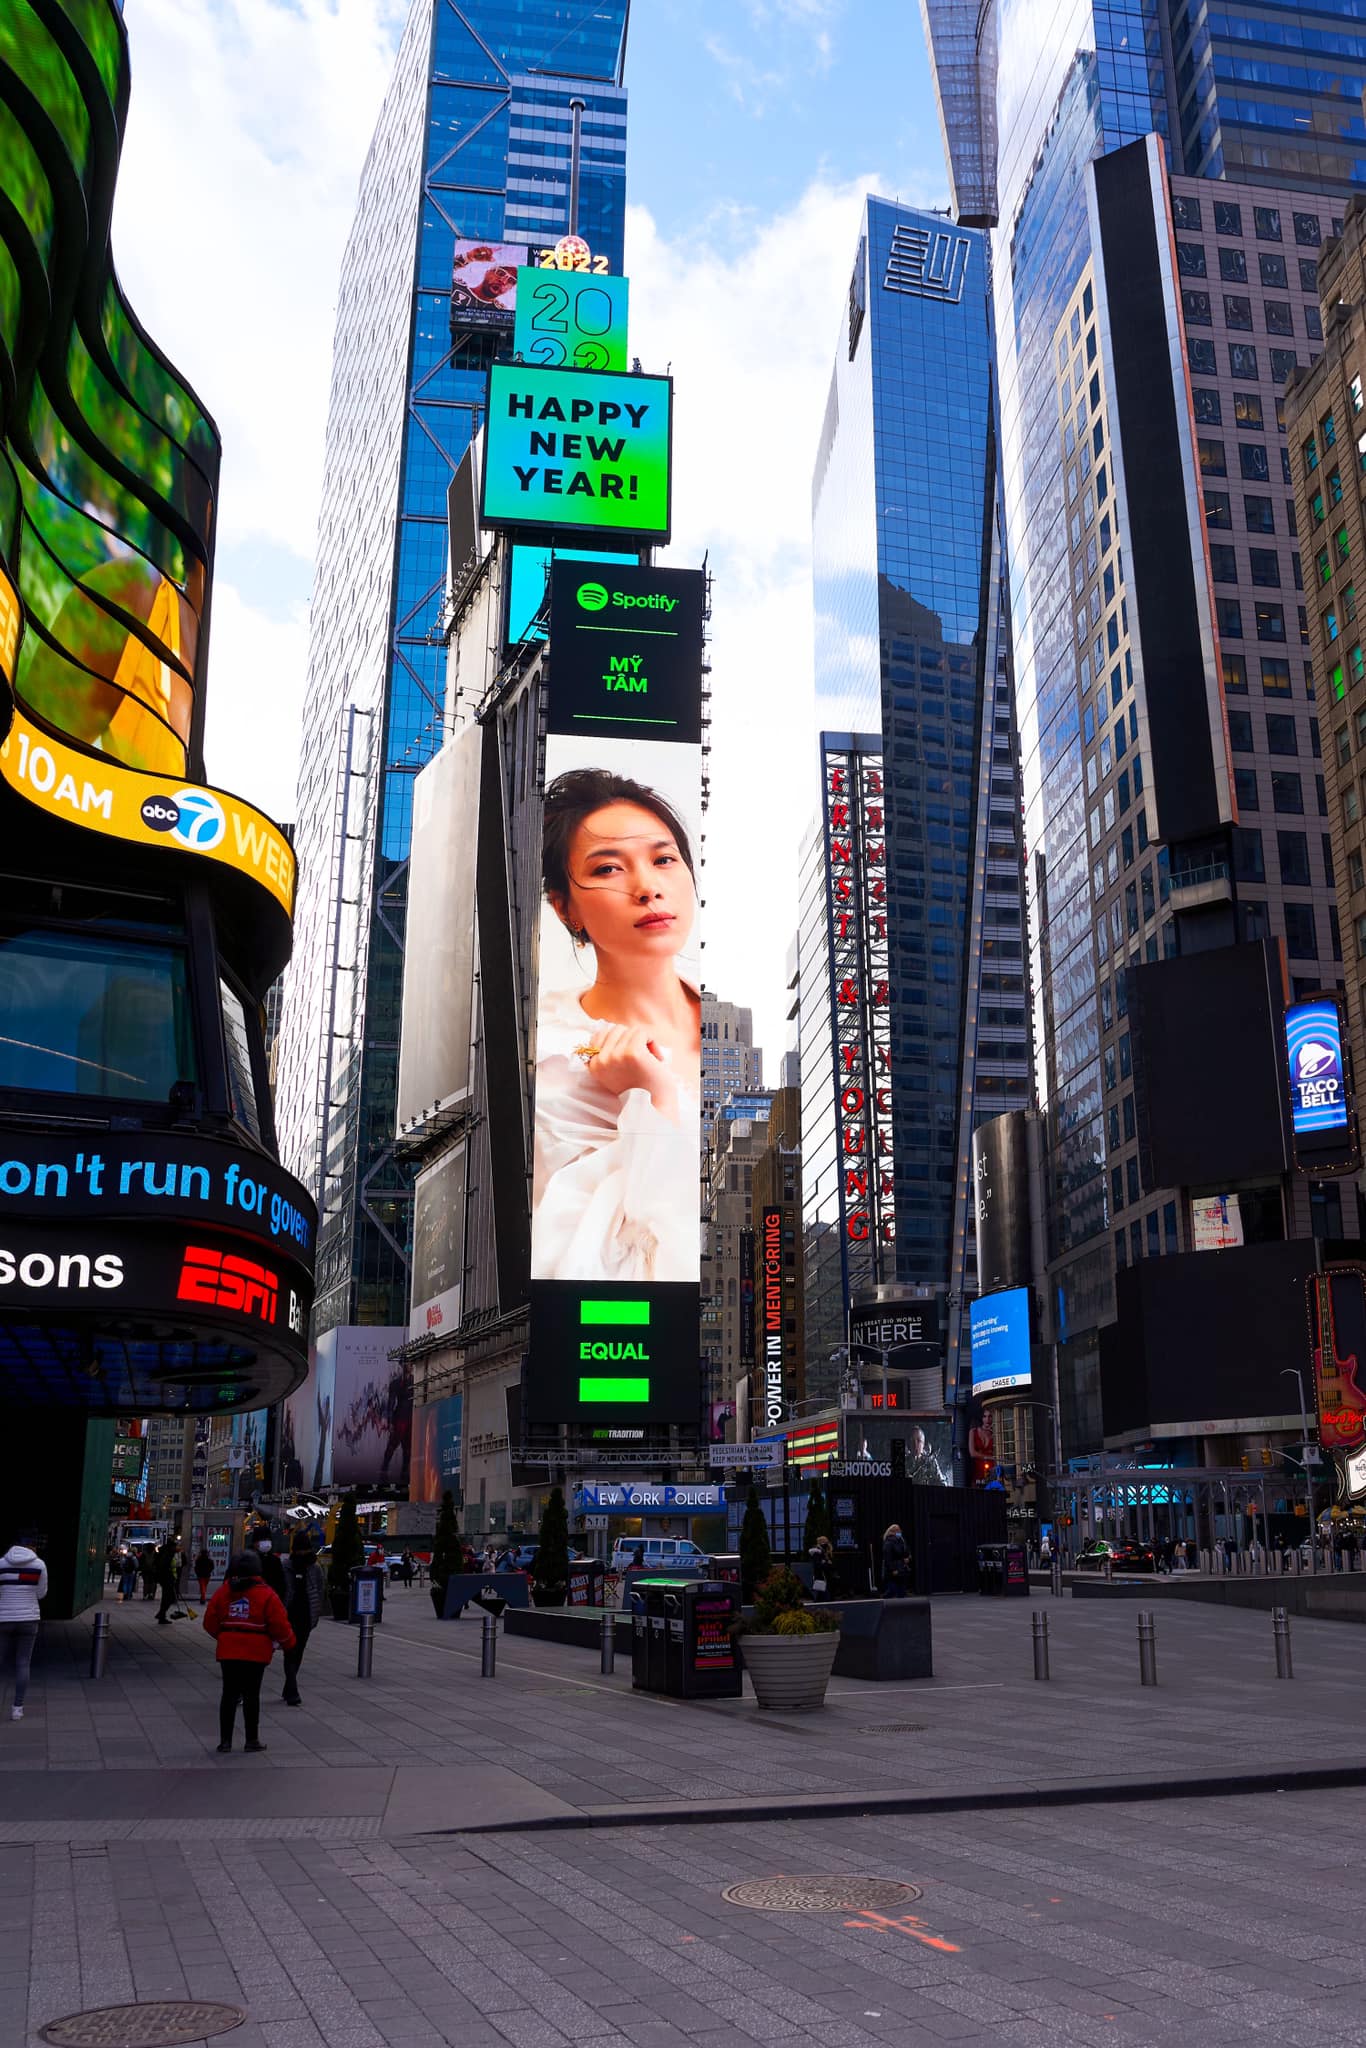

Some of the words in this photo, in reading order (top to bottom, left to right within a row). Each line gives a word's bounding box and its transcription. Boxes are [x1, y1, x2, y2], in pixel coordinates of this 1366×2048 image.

[539, 249, 609, 275] 2022
[532, 283, 612, 336] 20
[508, 393, 649, 428] HAPPY
[529, 431, 626, 462] NEW
[512, 466, 638, 500] YEAR!
[612, 591, 677, 612] Spotify
[602, 673, 648, 693] TÂM
[18, 733, 114, 820] 10AM
[142, 804, 178, 823] abc
[831, 769, 854, 939] ERNST
[837, 978, 858, 1005] &
[1297, 1078, 1339, 1096] TACO
[1301, 1090, 1340, 1108] BELL
[841, 1045, 871, 1242] YOUNG
[119, 1161, 212, 1200] run
[223, 1163, 268, 1216] for
[765, 1214, 781, 1331] MENTORING
[176, 1246, 279, 1324] ESPN
[867, 1323, 922, 1344] HERE
[579, 1342, 650, 1360] EQUAL
[766, 1336, 781, 1355] IN
[767, 1361, 782, 1428] POWER
[1322, 1411, 1346, 1425] Hard
[712, 1446, 744, 1455] PEDESTRIAN
[712, 1456, 726, 1464] KEEP
[845, 1461, 892, 1477] HOTDOGS
[584, 1486, 618, 1505] NEW
[620, 1486, 660, 1505] YORK
[664, 1486, 713, 1505] POLICE
